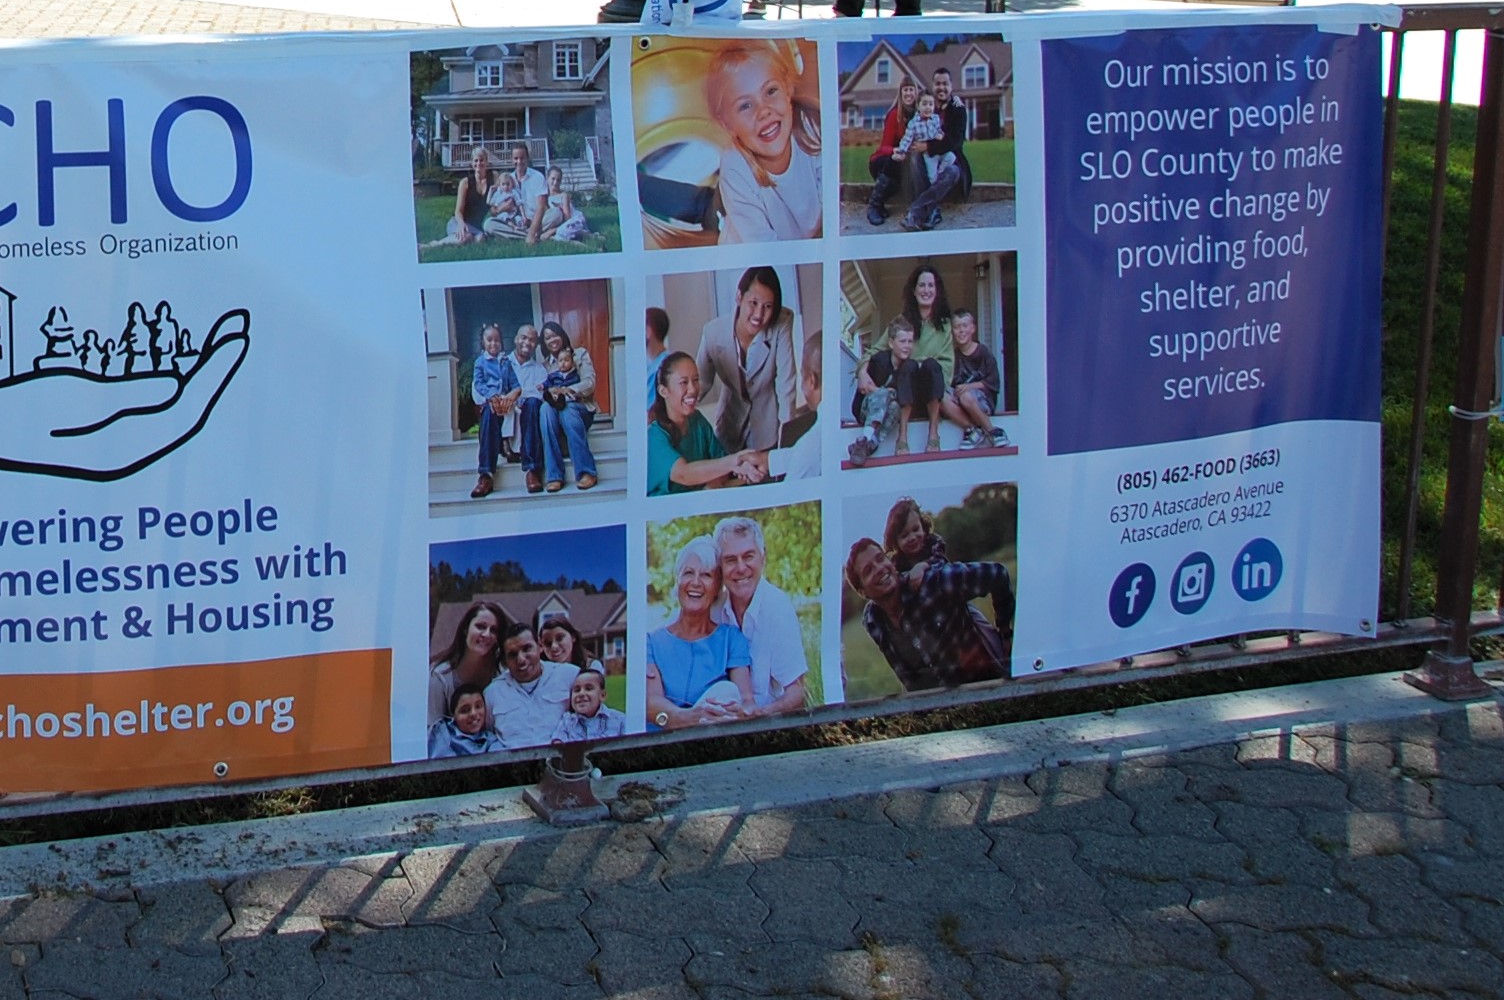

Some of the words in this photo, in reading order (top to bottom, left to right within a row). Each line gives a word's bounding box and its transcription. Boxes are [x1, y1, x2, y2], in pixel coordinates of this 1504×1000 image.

[1104, 59, 1153, 88] Our
[1162, 56, 1267, 86] mission
[1275, 54, 1297, 82] is
[1304, 55, 1330, 81] to
[1086, 106, 1220, 141] empower
[1228, 96, 1315, 137] people
[1320, 95, 1339, 123] in
[1080, 150, 1132, 181] SLO
[1141, 147, 1243, 182] County
[1251, 146, 1276, 171] to
[1284, 137, 1343, 169] make
[1094, 193, 1200, 234] positive
[1209, 188, 1300, 222] change
[1306, 182, 1330, 216] by
[100, 231, 239, 259] Organization
[1116, 234, 1247, 278] providing
[1253, 226, 1308, 259] food,
[1140, 280, 1240, 313] shelter,
[1247, 271, 1291, 303] and
[1149, 318, 1281, 362] supportive
[1163, 366, 1265, 400] services.
[1117, 470, 1157, 494] (805)
[1161, 457, 1236, 485] 462-FOOD
[1239, 448, 1281, 474] (3663)
[138, 498, 278, 545] People
[1110, 502, 1148, 523] 6370
[1151, 490, 1231, 518] Atascadero
[1233, 480, 1284, 501] Avenue
[1120, 518, 1203, 544] Atascadero,
[1207, 509, 1227, 527] CA
[1230, 500, 1272, 524] 93422
[255, 542, 347, 581] with
[121, 605, 152, 638] &
[167, 592, 335, 635] Housing
